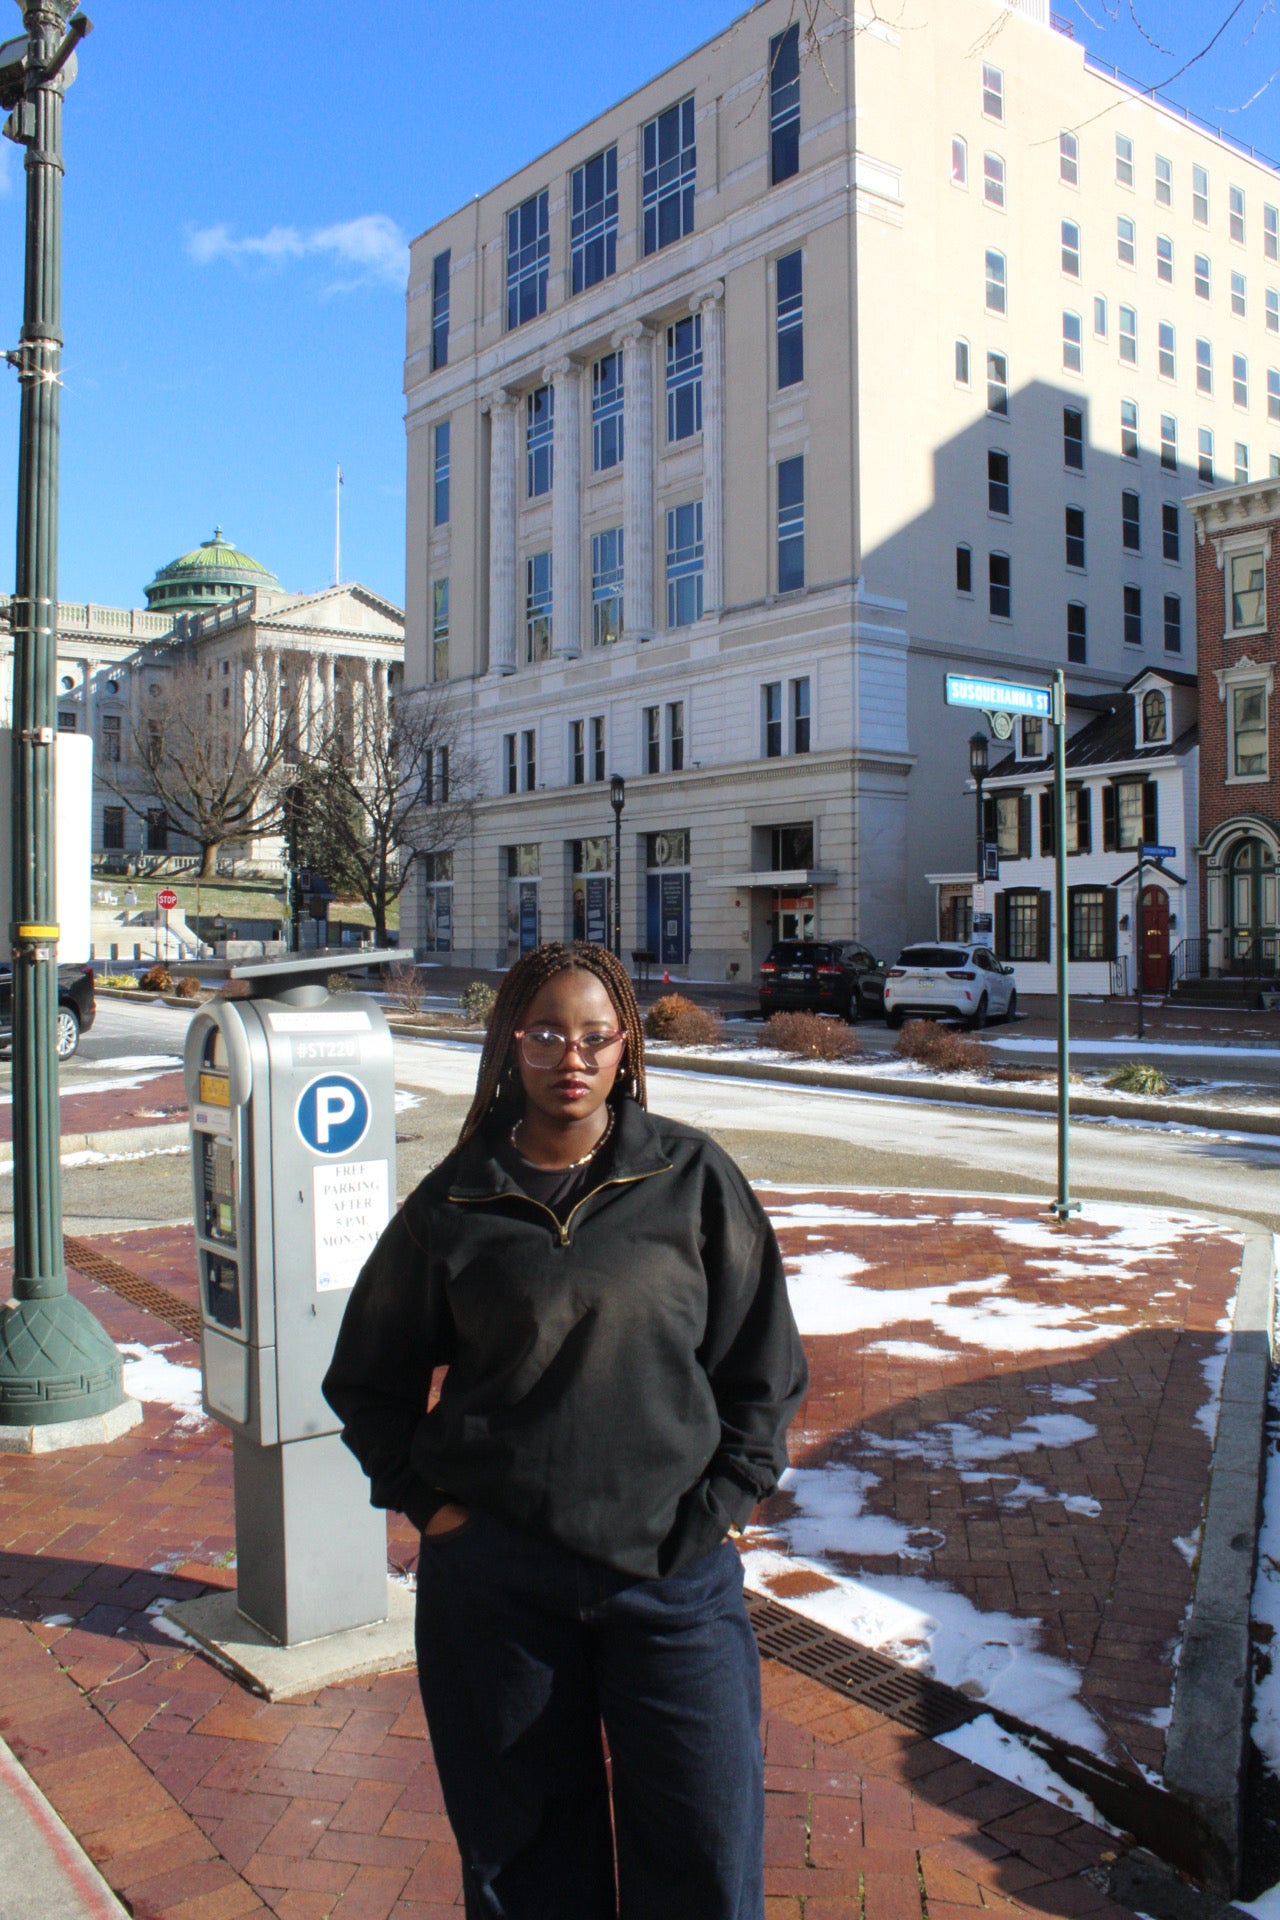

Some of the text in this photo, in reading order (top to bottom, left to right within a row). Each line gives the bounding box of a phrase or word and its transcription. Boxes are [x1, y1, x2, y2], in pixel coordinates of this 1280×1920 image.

[951, 682, 1049, 711] SUSQUEHANNA ST
[159, 895, 176, 904] STOP
[315, 1086, 355, 1144] P
[335, 1163, 366, 1177] FREE
[323, 1180, 380, 1196] PARKING
[333, 1197, 373, 1212] AFTER
[336, 1217, 343, 1228] 5
